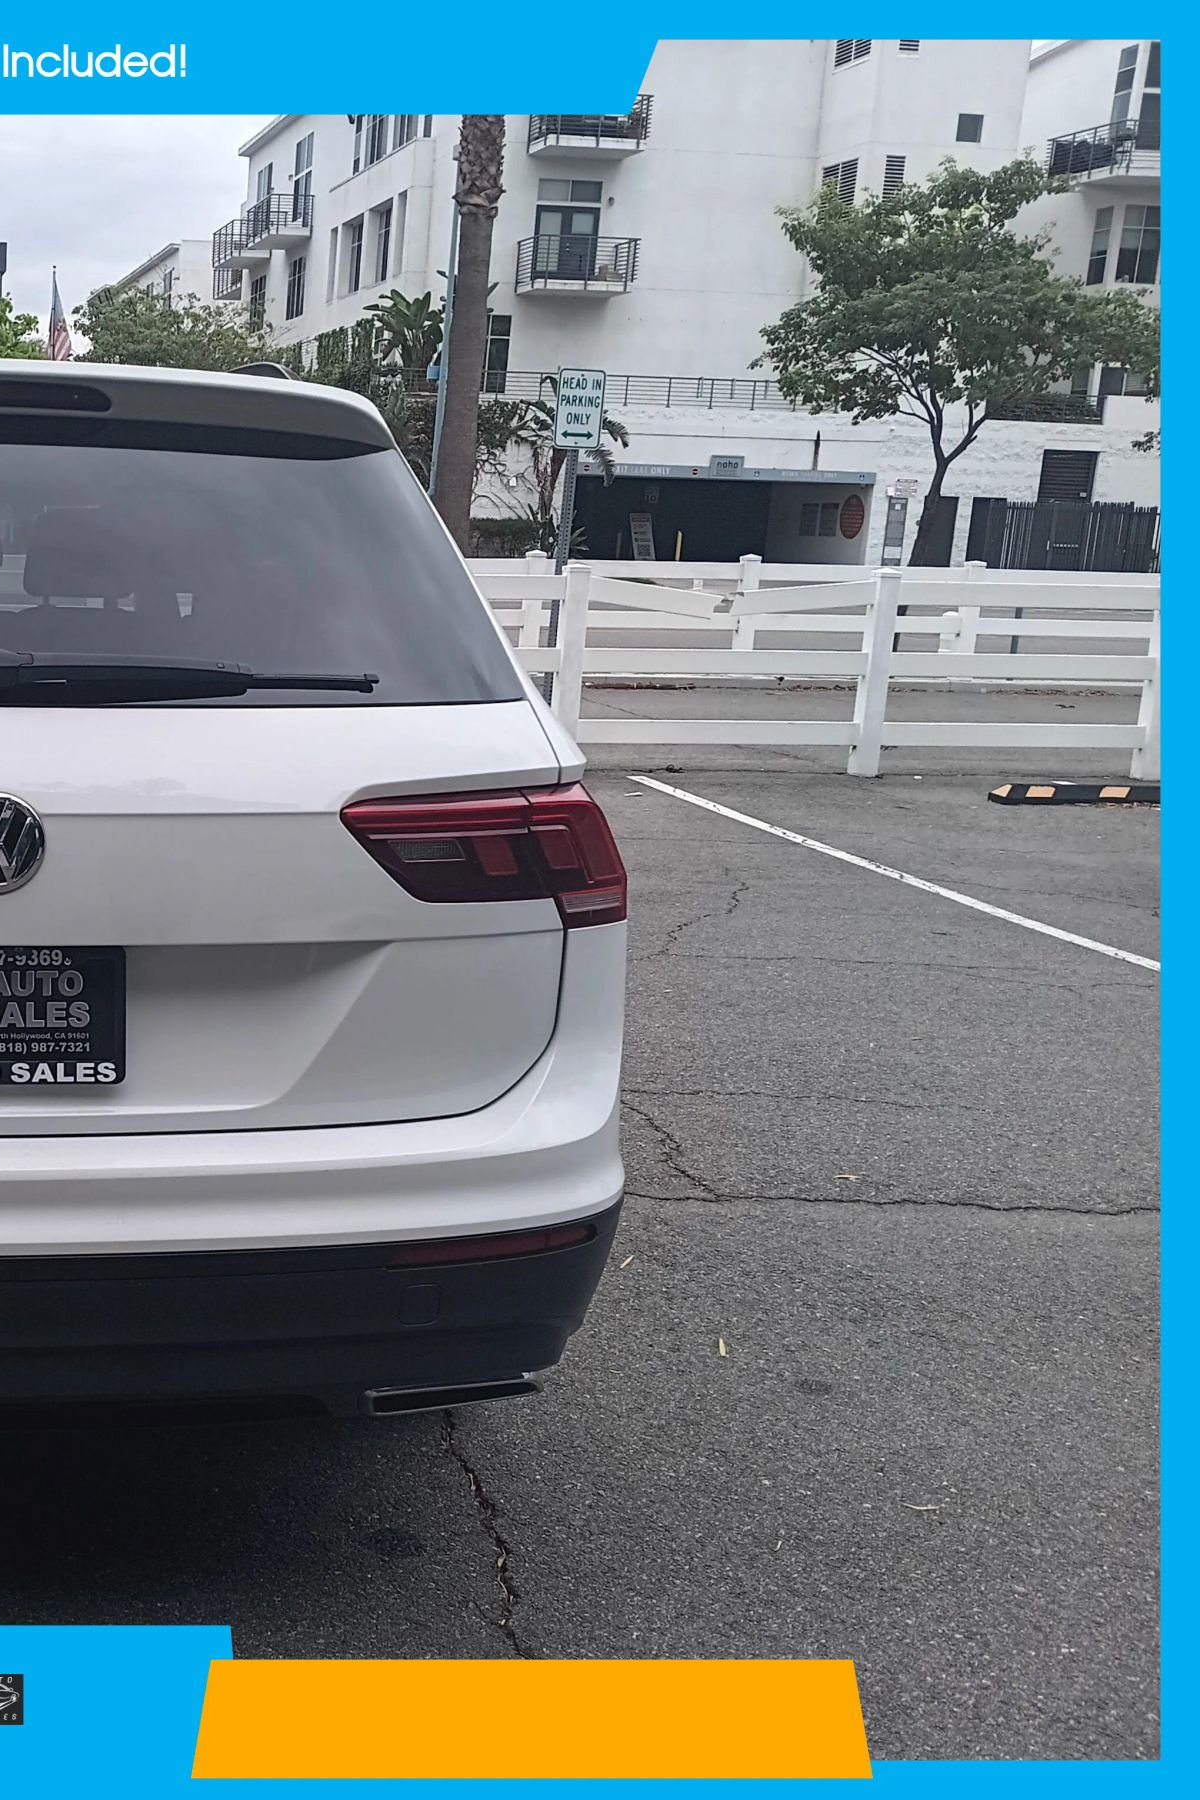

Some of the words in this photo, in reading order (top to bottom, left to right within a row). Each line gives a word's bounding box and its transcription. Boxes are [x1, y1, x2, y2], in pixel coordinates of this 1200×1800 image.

[562, 376, 588, 391] HEAD
[592, 378, 602, 391] IN
[560, 394, 600, 408] PARKING
[566, 412, 591, 425] ONLY
[650, 466, 671, 475] ONLY
[10, 1032, 53, 1041] Hollywood,
[31, 1042, 90, 1053] 987-7321
[10, 1062, 117, 1083] SALES
